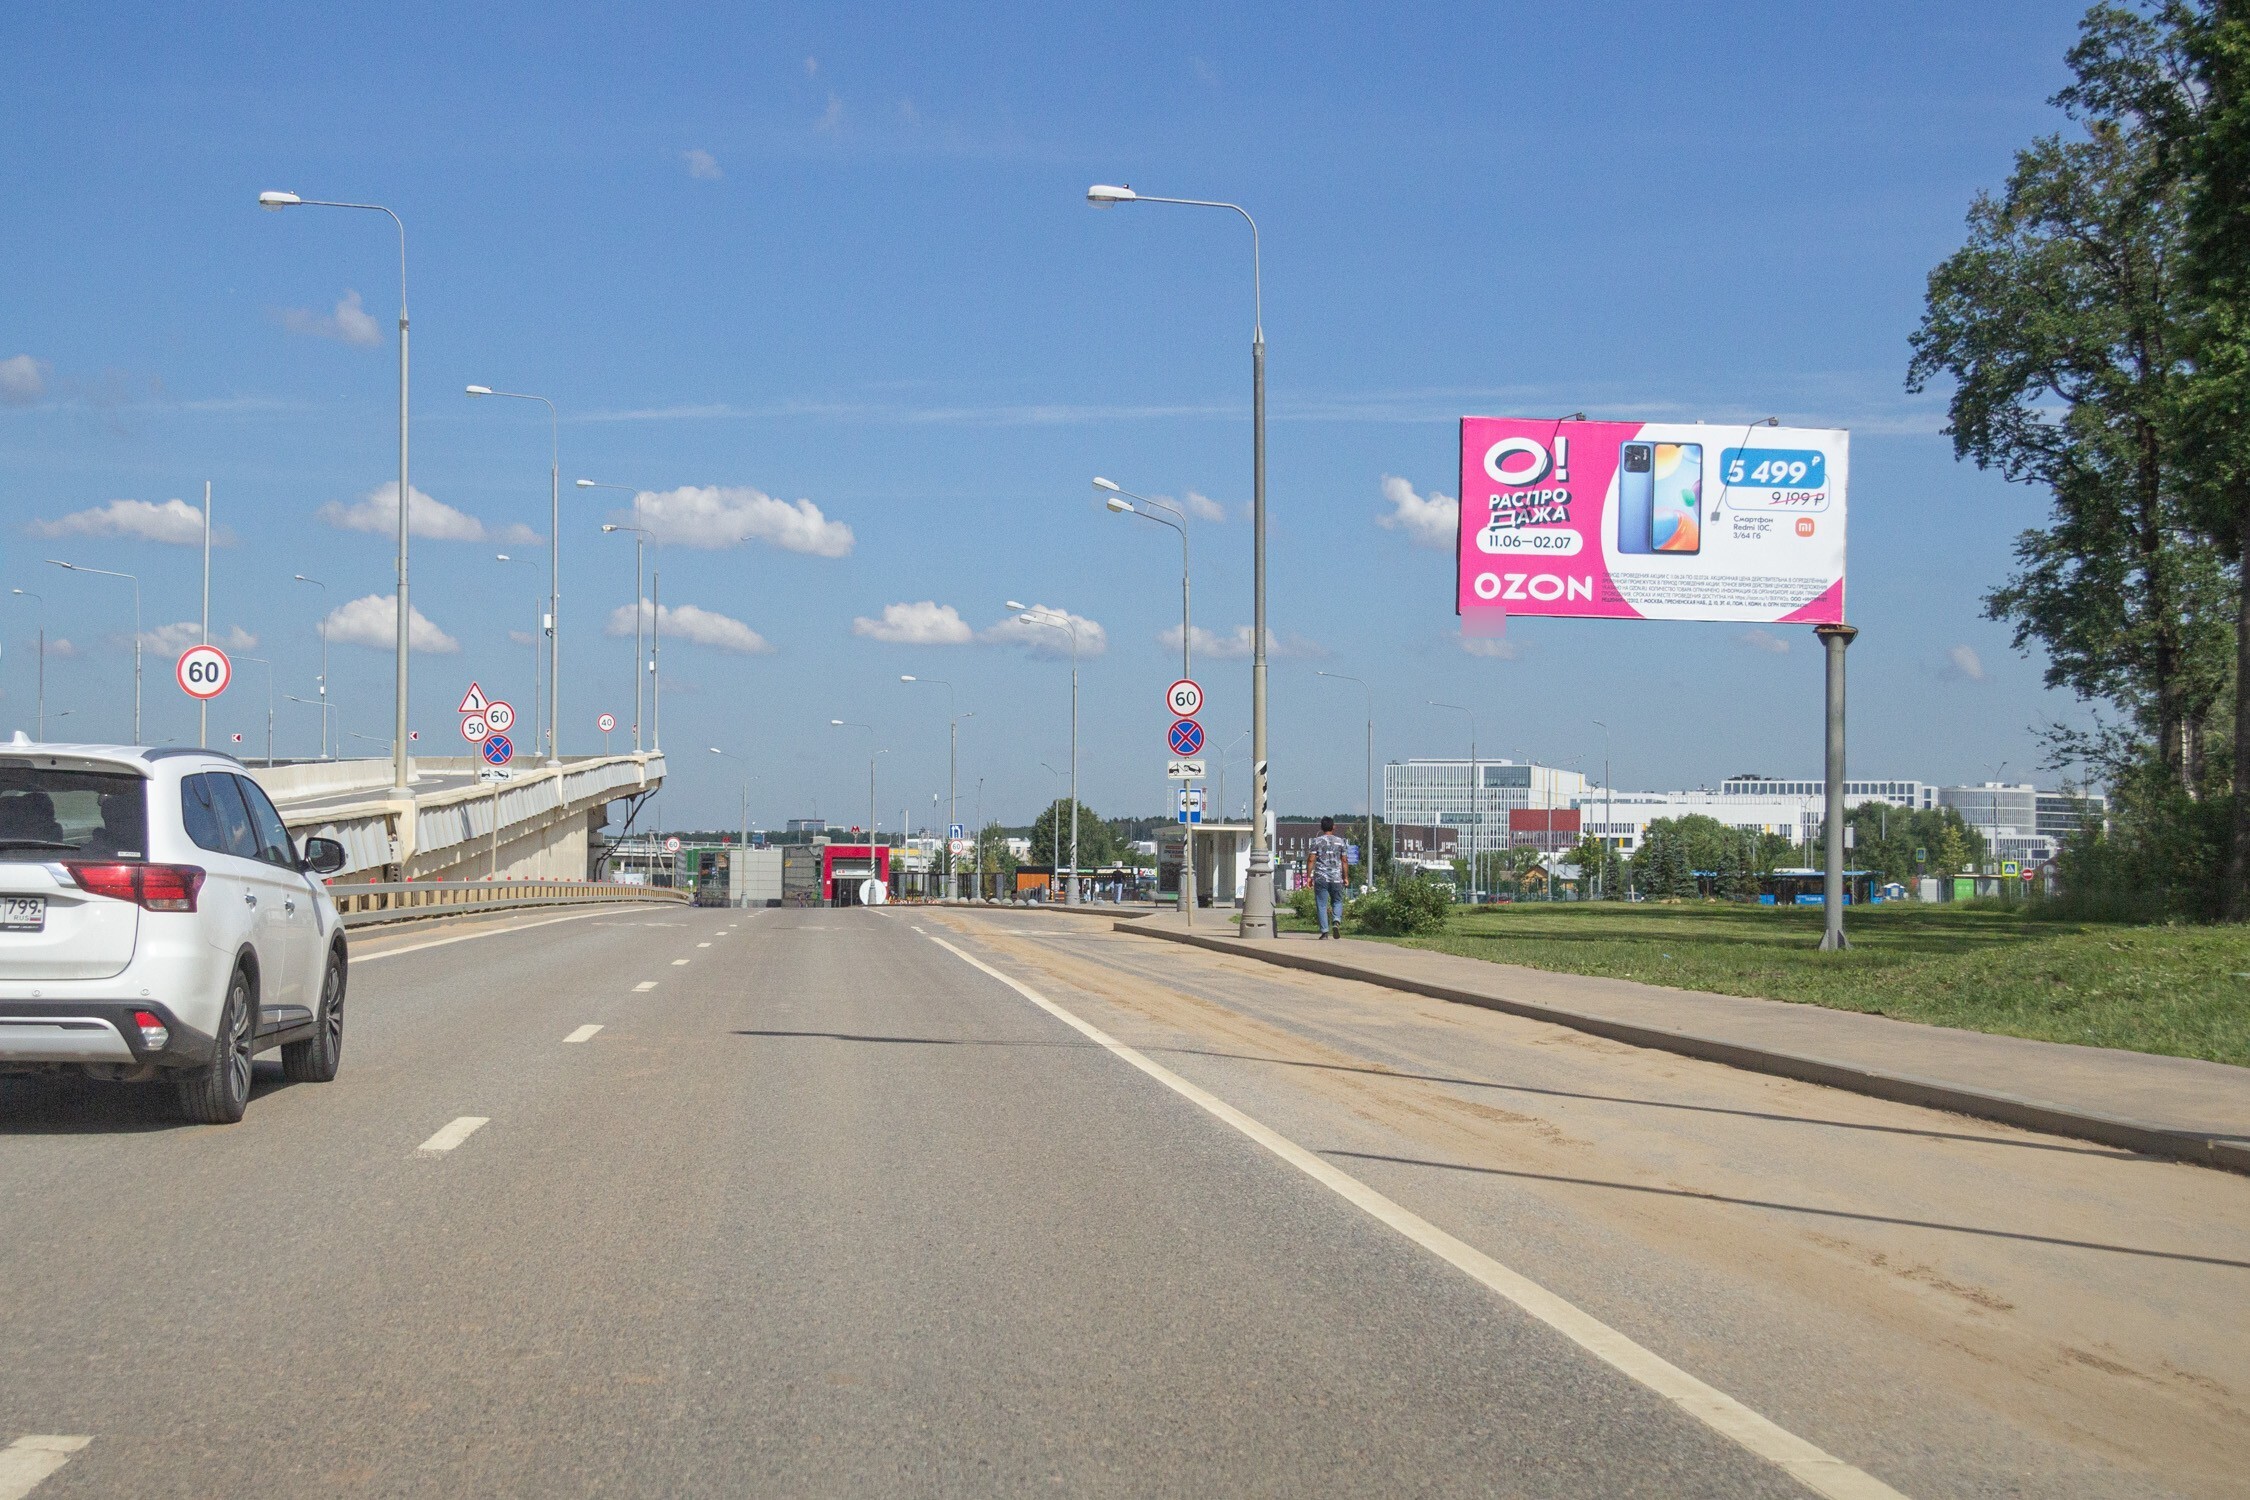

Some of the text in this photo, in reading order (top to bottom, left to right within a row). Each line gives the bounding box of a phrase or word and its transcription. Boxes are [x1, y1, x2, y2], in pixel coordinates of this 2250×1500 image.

[1726, 459, 1745, 483] 5
[1750, 460, 1807, 484] 499
[1488, 487, 1571, 511] РАСПРО
[1487, 504, 1570, 531] ДАЖА
[1733, 515, 1774, 524] Смартфон
[1733, 523, 1756, 531] Redmi
[1733, 531, 1762, 540] 3/64 Гб
[1473, 572, 1593, 602] OZON
[189, 661, 219, 683] 60
[1175, 691, 1197, 706] 60
[490, 710, 509, 723] 60
[601, 718, 612, 726] 40
[468, 722, 485, 734] 50
[8, 899, 38, 915] 799
